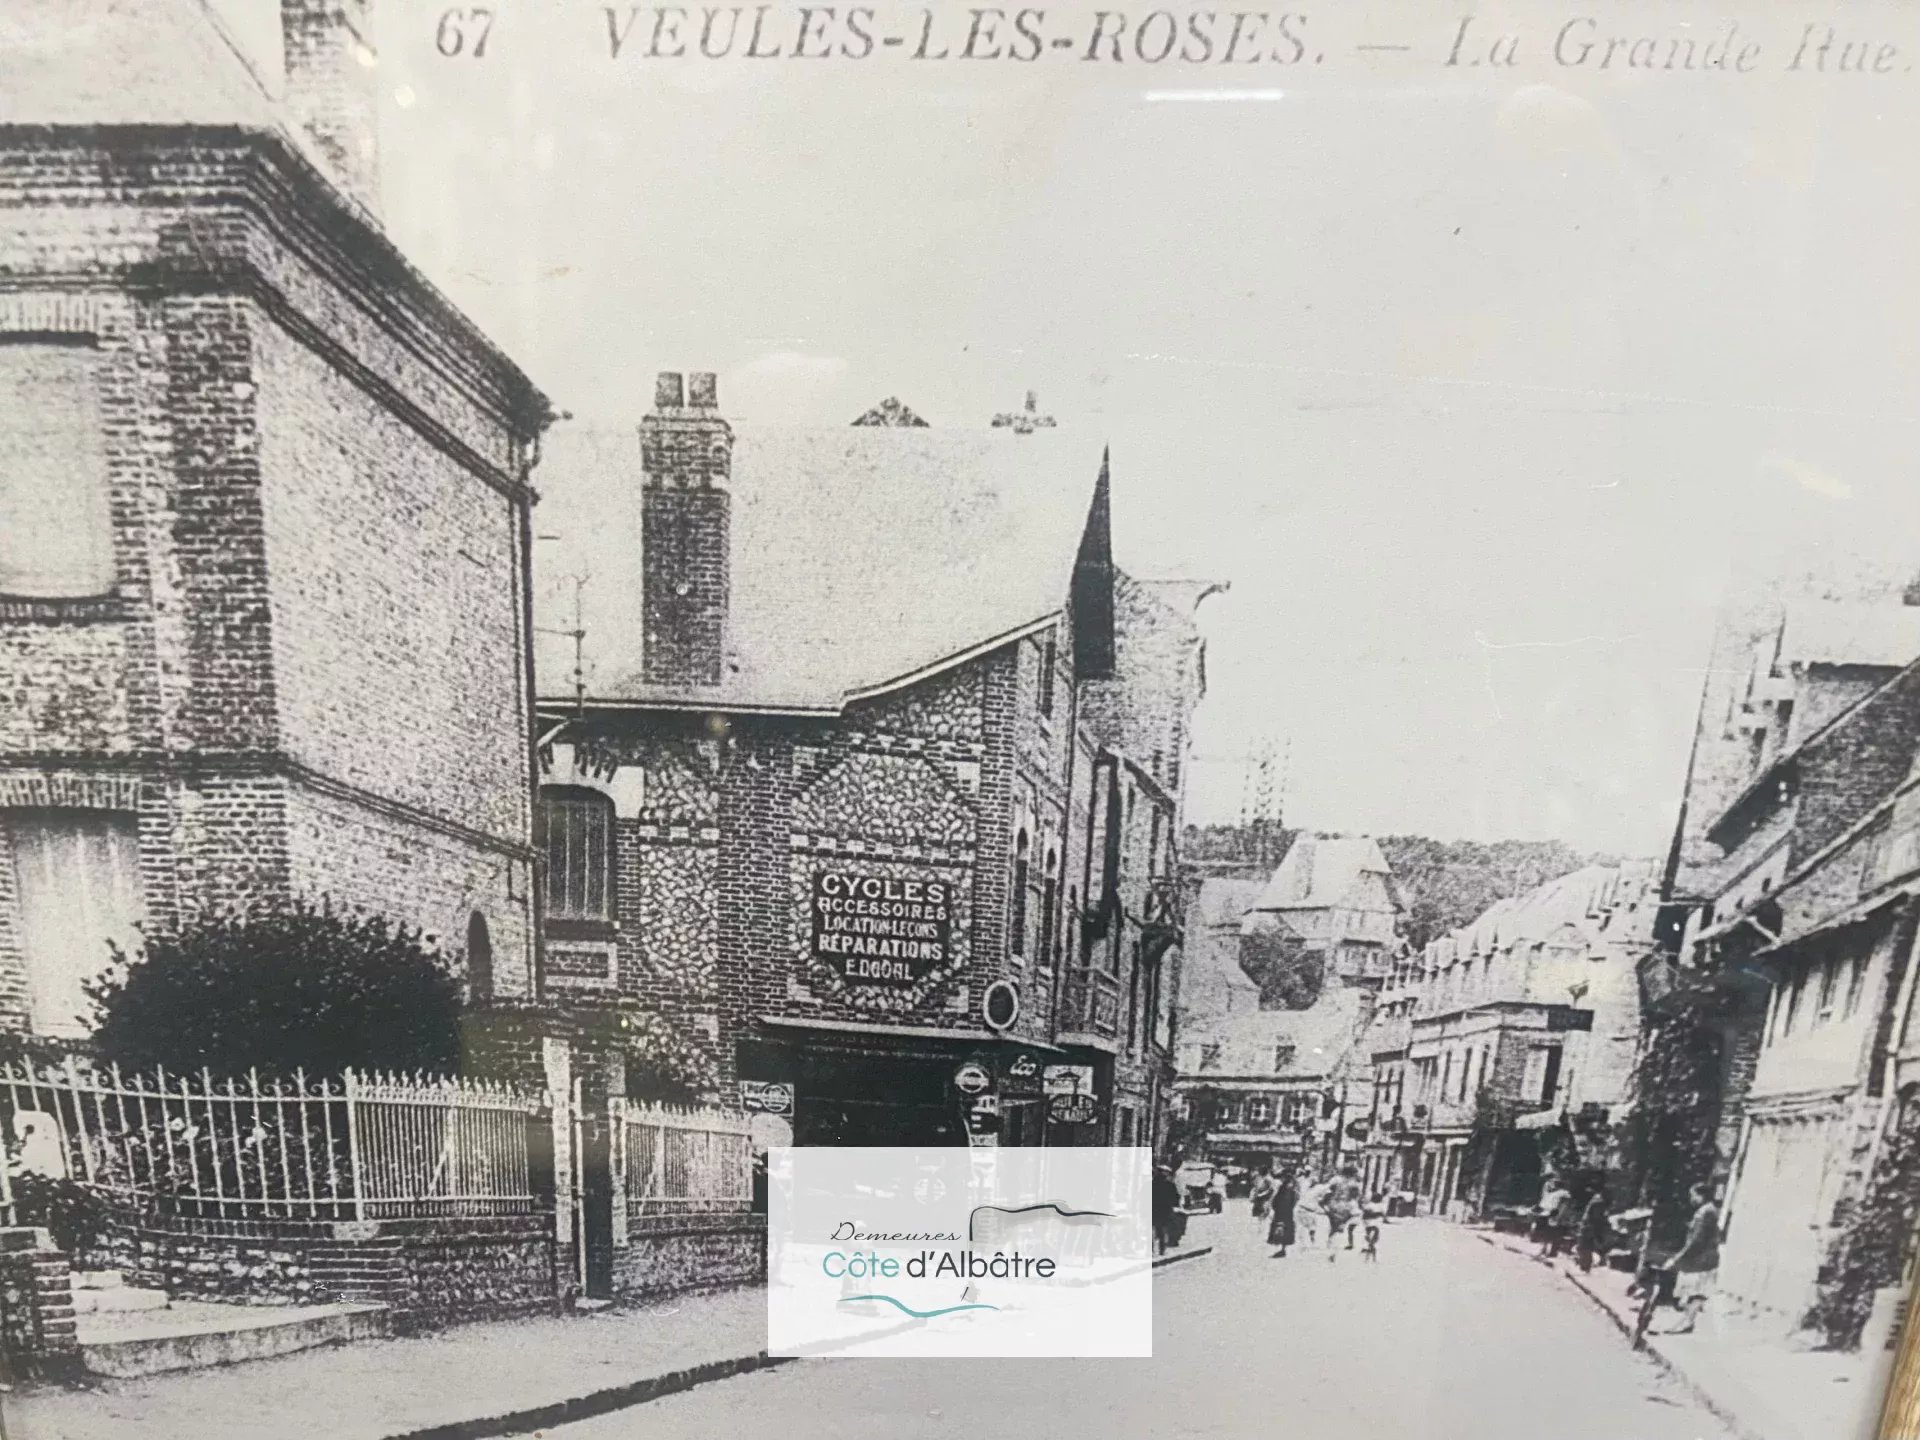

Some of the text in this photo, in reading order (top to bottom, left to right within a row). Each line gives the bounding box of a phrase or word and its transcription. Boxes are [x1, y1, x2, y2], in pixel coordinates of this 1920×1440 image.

[436, 7, 495, 58] 67
[602, 6, 1324, 65] VEULES-LES-ROSES.
[1442, 15, 1520, 68] La
[1554, 17, 1763, 74] Grande
[821, 873, 946, 903] CYCLES
[817, 896, 947, 921] ACCESSOIRES
